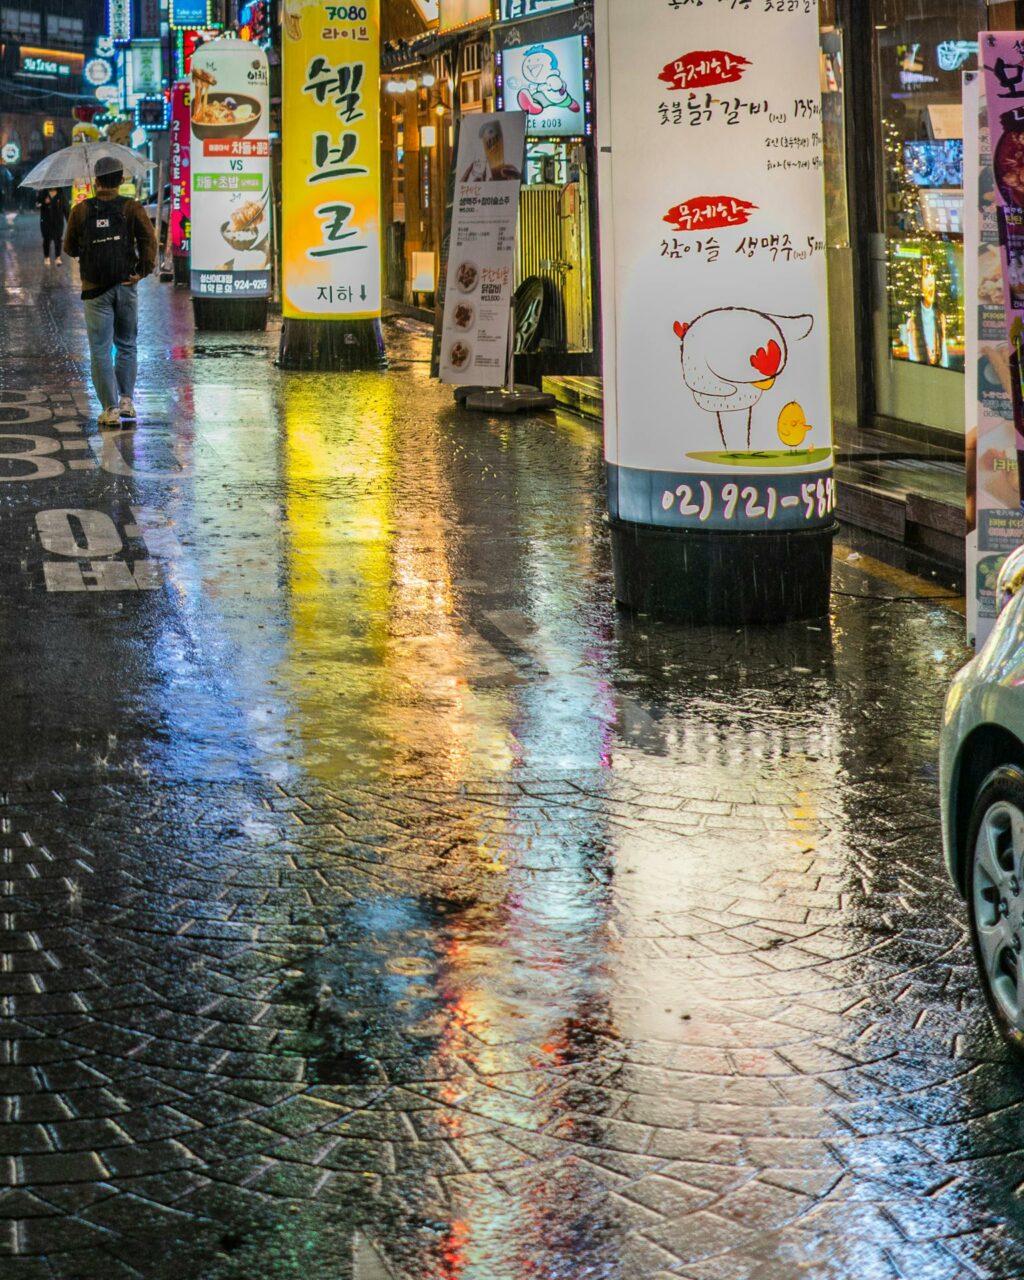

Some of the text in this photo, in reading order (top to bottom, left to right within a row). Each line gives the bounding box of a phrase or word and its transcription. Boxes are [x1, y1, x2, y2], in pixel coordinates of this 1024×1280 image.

[324, 6, 367, 21] 7080
[322, 27, 370, 42] 라이브
[673, 55, 736, 89] 무제한
[541, 118, 562, 130] 2003
[229, 159, 243, 171] VS
[304, 57, 368, 257] 쉘브르
[677, 201, 743, 230] 무제한
[661, 237, 721, 263] 참이슬
[734, 234, 793, 262] 생맥주
[316, 284, 353, 304] 지하
